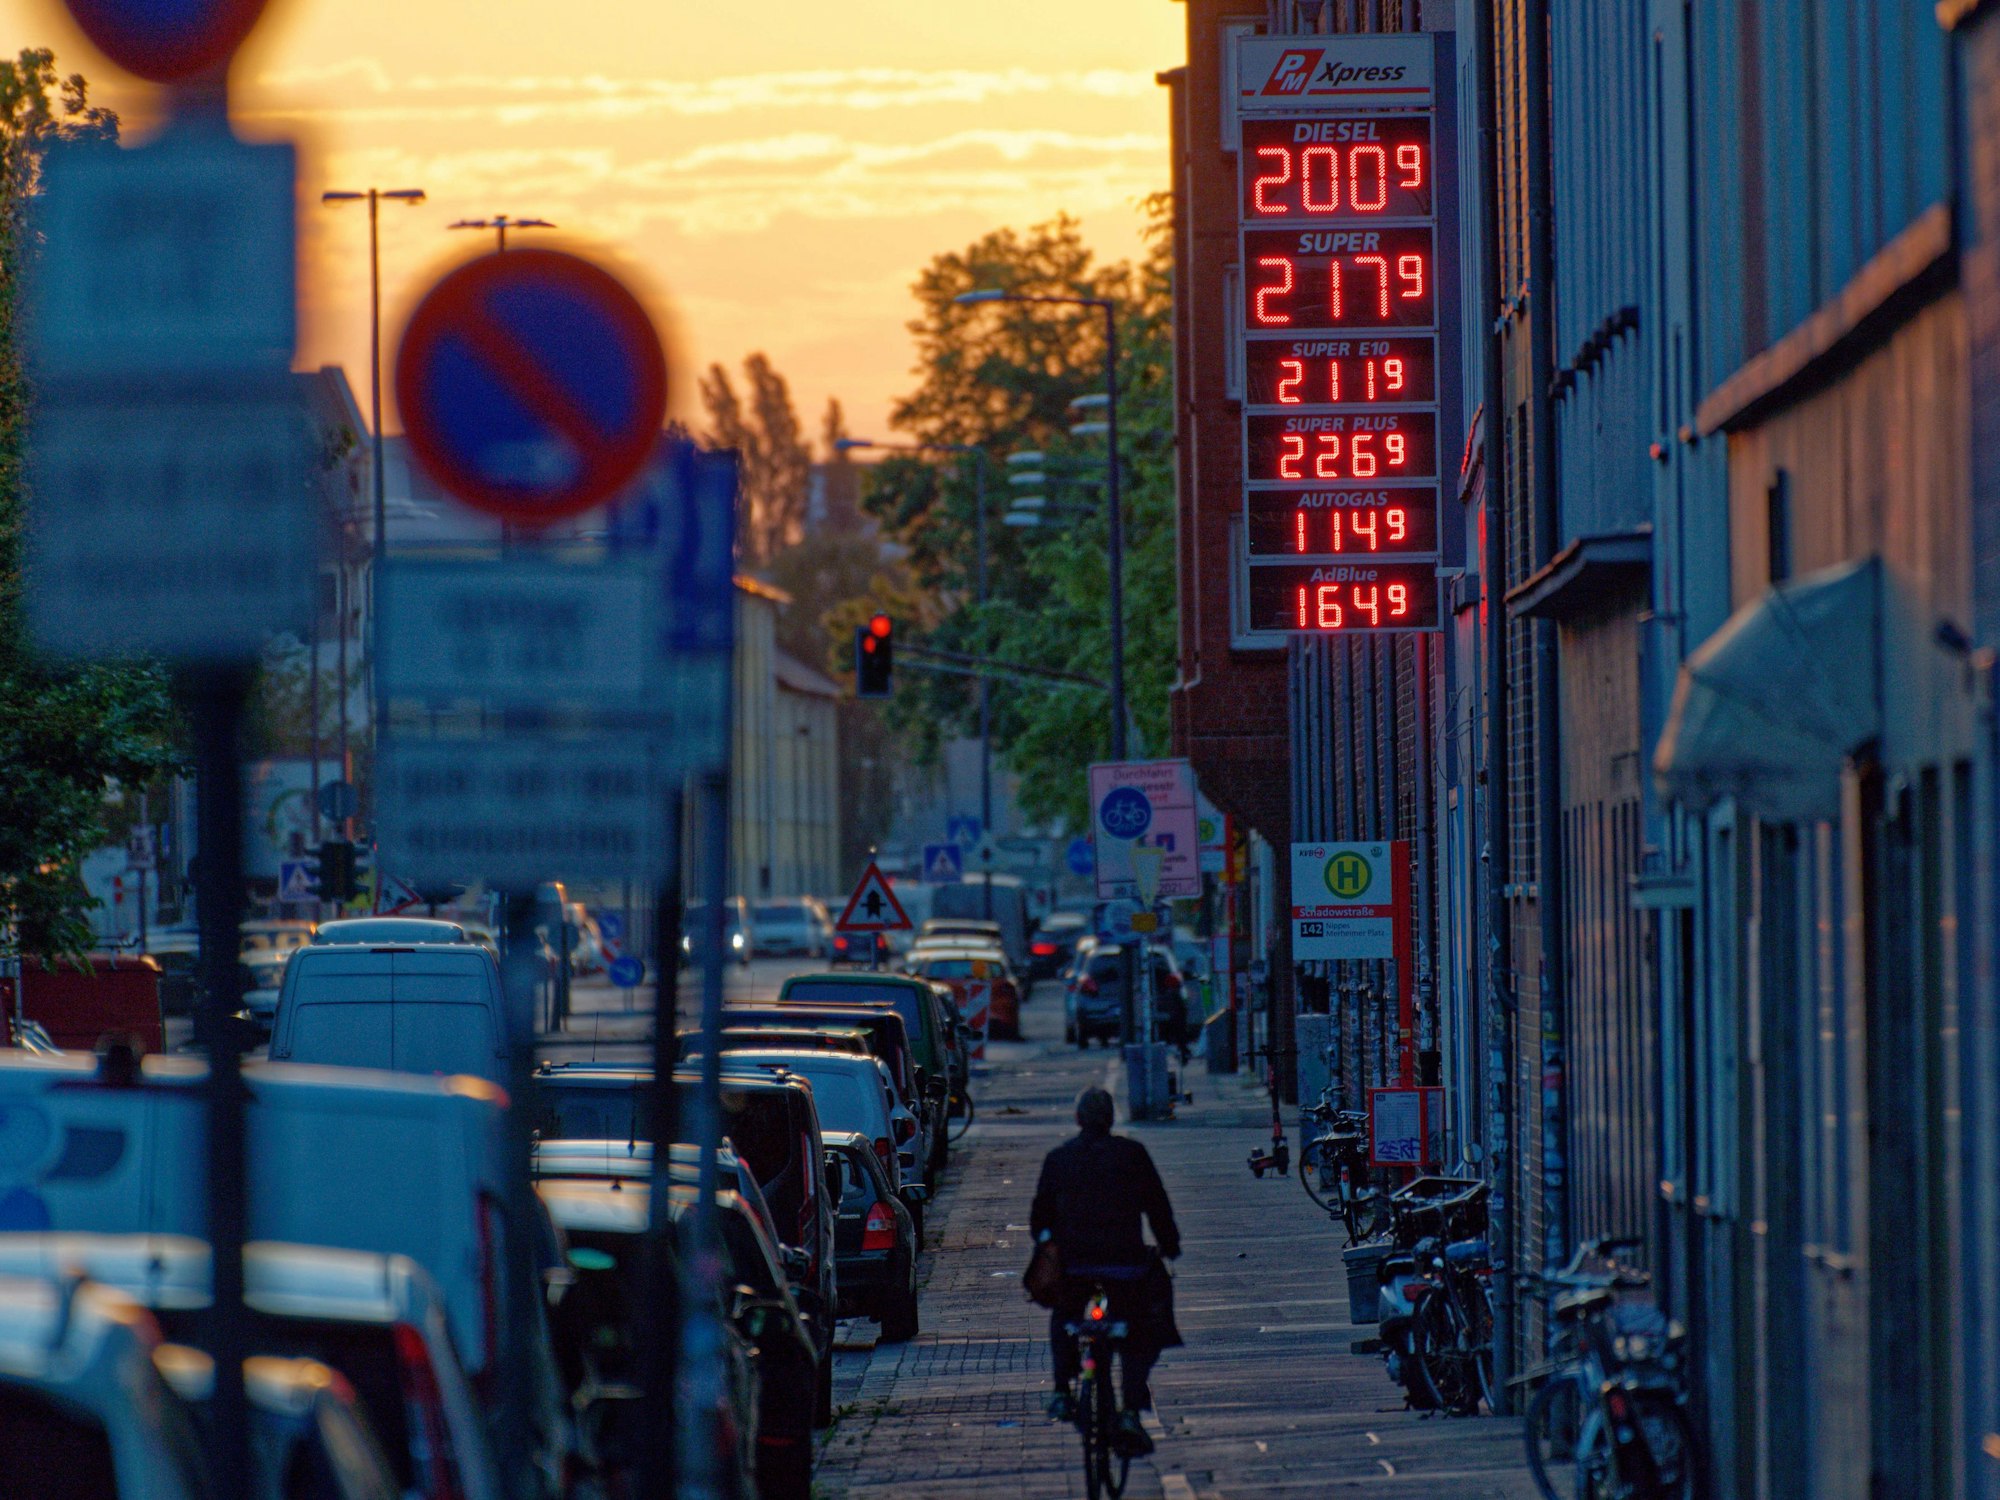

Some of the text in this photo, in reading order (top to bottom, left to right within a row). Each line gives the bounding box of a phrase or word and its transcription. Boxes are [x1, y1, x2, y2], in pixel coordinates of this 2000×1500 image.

[1317, 62, 1406, 87] Xpress
[1293, 122, 1381, 142] DIESEL
[1298, 232, 1380, 253] SUPER
[1291, 341, 1390, 357] SUPER E10
[1285, 416, 1398, 432] SUPER PLUS
[1298, 492, 1388, 507] AUTOGAS
[1310, 567, 1378, 582] AdBlue
[1113, 768, 1173, 780] Durchfahrt
[1338, 861, 1359, 890] H
[1299, 907, 1375, 917] Schadowstraße
[1302, 924, 1322, 935] 142
